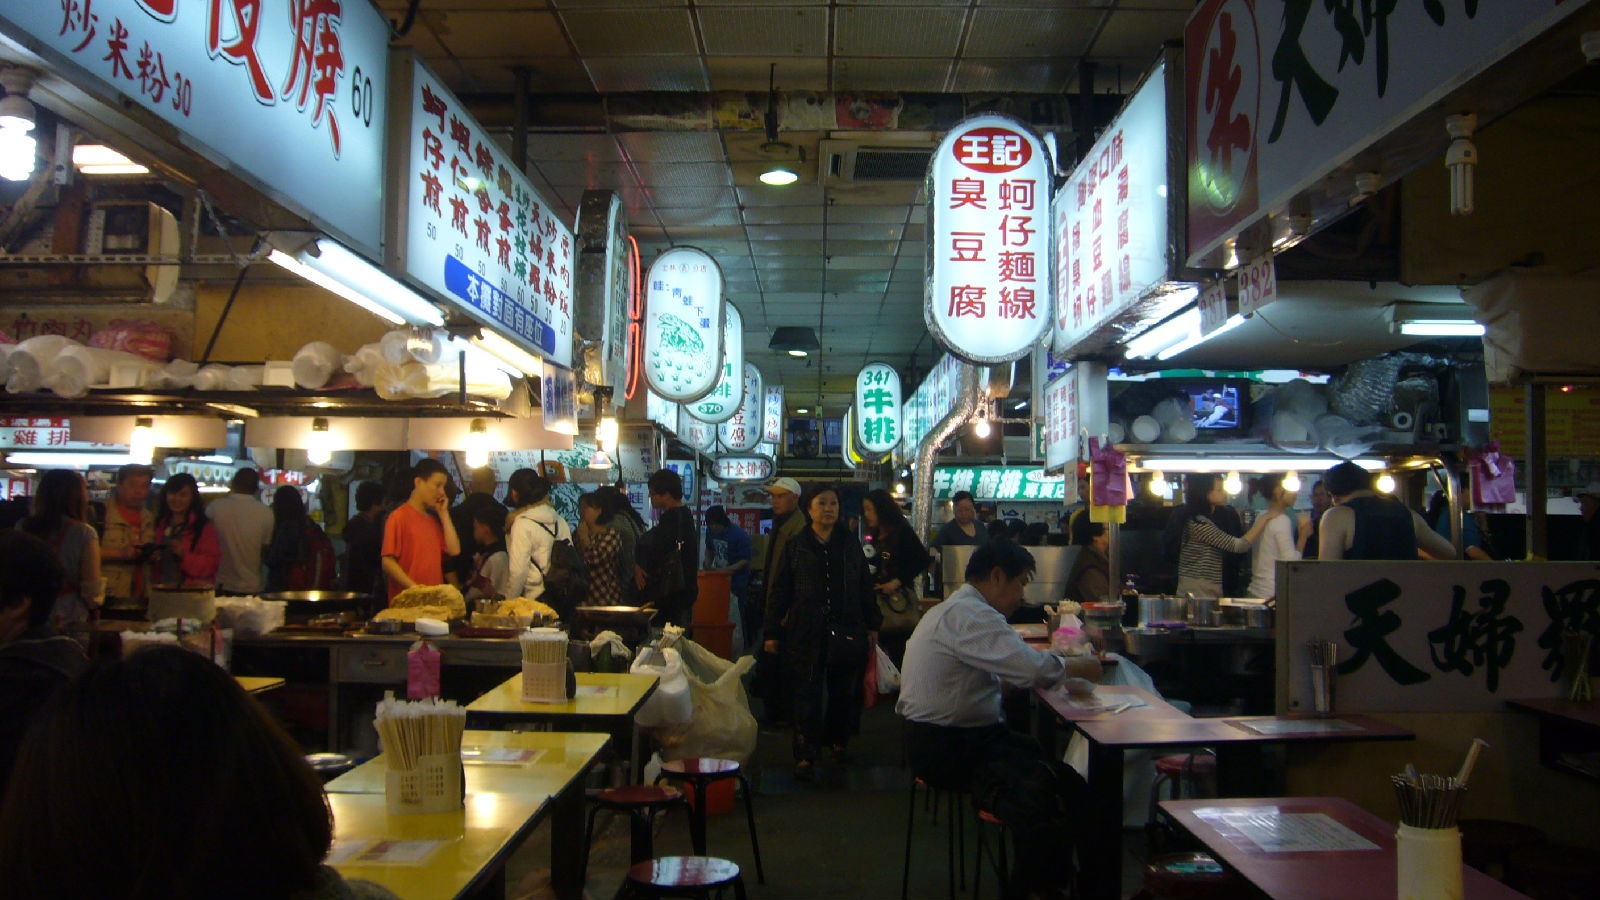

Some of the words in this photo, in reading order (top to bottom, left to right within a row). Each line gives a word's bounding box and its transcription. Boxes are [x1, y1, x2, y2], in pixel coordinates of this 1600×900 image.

[171, 72, 192, 117] 30
[351, 65, 372, 128] 60
[420, 83, 448, 218] 蚵仔煎
[961, 135, 1022, 166] 王記
[449, 113, 474, 239] 蝦仁煎
[427, 222, 437, 241] 50
[455, 243, 464, 261] 50
[529, 201, 544, 295] 天婦羅
[948, 177, 987, 318] 臭豆腐
[998, 178, 1036, 319] 蚵仔麵線
[478, 260, 486, 277] 50
[543, 215, 558, 306] 炒米粉
[517, 286, 525, 305] 60
[530, 295, 538, 314] 50
[1240, 260, 1273, 307] 382
[864, 369, 891, 386] 341
[700, 404, 721, 413] 370
[864, 388, 895, 444] 牛排
[14, 429, 69, 446] 雞排
